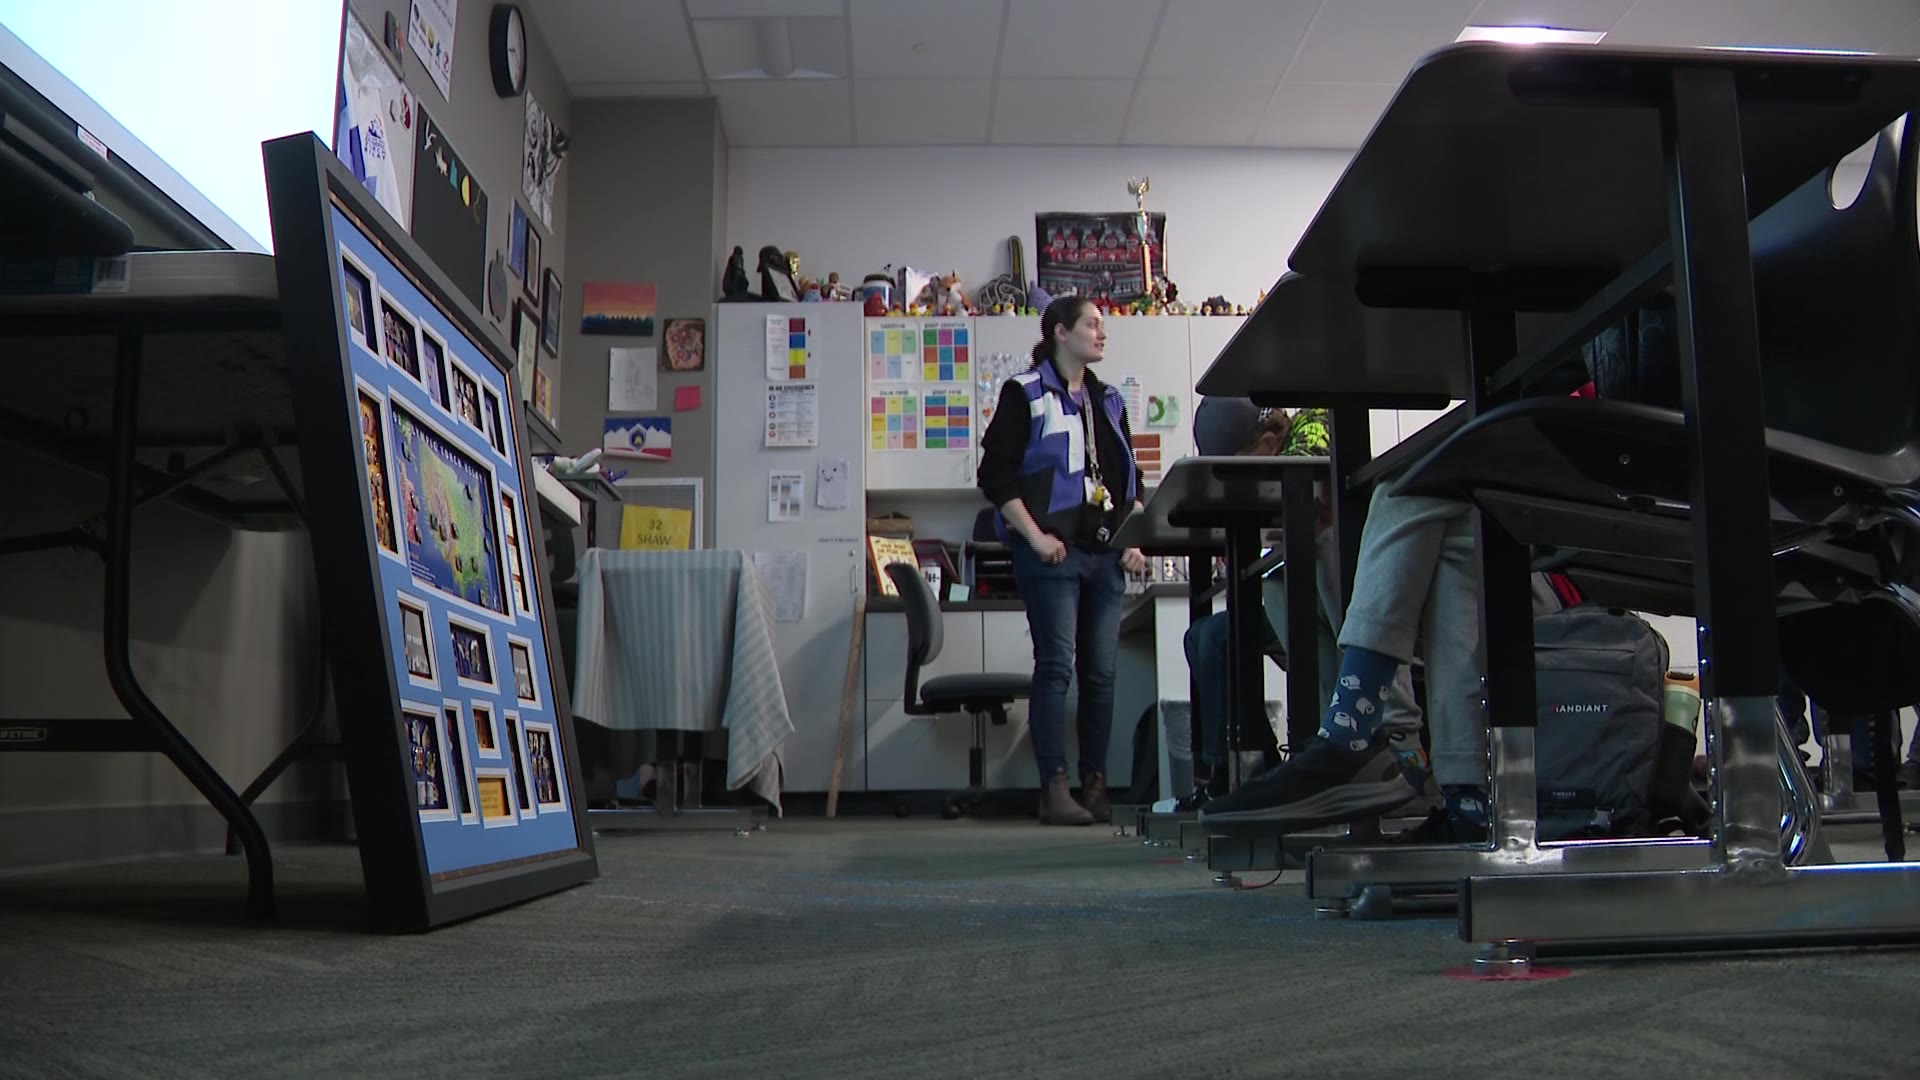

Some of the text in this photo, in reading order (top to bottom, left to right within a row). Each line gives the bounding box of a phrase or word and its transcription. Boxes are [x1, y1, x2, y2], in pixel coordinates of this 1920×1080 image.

[649, 519, 662, 531] 32
[637, 533, 672, 546] SHAW
[0, 730, 40, 739] IFETIME
